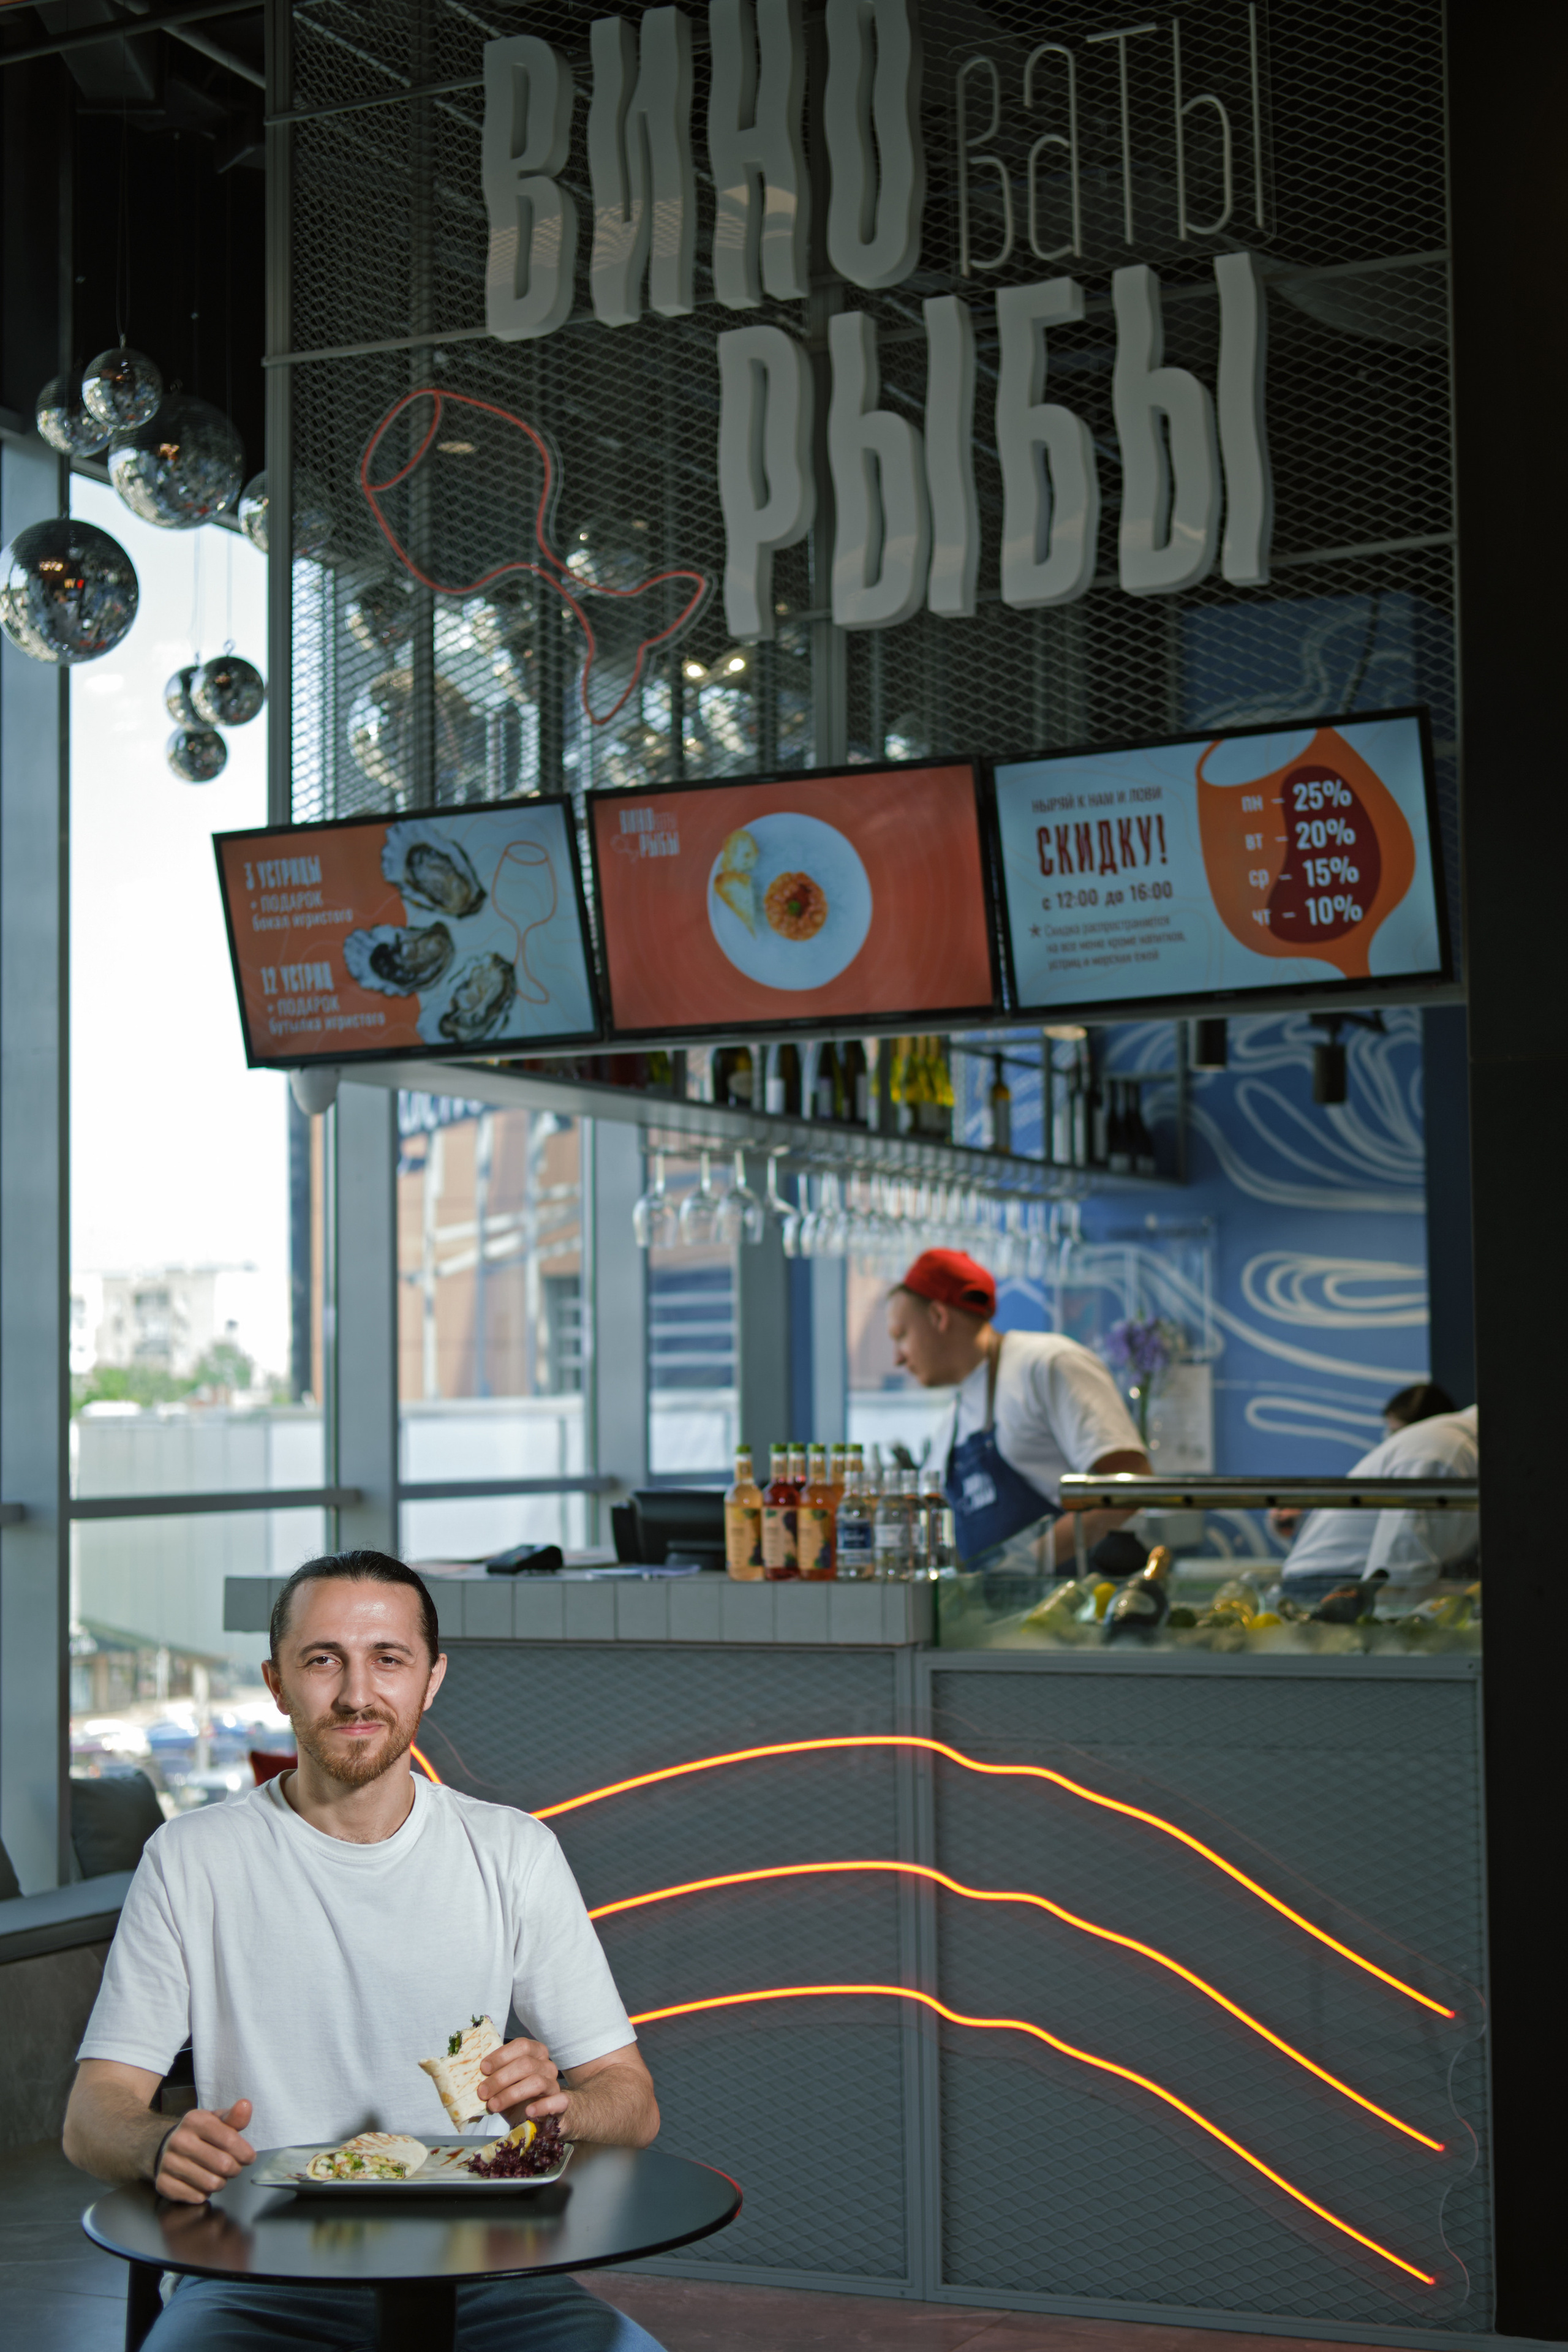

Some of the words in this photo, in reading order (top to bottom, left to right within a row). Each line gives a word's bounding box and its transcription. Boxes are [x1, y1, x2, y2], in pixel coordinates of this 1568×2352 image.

[480, 0, 926, 342] ВИНО
[717, 252, 1272, 641] РЫБЫ
[1031, 792, 1074, 813] НЫРЯЙ
[1088, 791, 1115, 807] НАМ
[1129, 786, 1162, 804] ЛОВИ
[1292, 778, 1352, 812] 25%
[1037, 813, 1167, 877] СКИДКУ!
[1295, 817, 1356, 850] 20%
[257, 855, 322, 889] УСТРИЦЫ
[1302, 856, 1359, 888] 15%
[261, 890, 323, 913] ПОДАРОК
[1057, 888, 1098, 909] 12:00
[1105, 891, 1124, 907] до
[1130, 880, 1173, 902] 16:00
[1305, 894, 1363, 926] 10%
[252, 913, 290, 932] бокал
[292, 908, 353, 930] игристого
[261, 966, 277, 995] 12
[280, 961, 334, 993] УСТРИЦ
[277, 994, 340, 1017] ПОДАРОК
[269, 1017, 322, 1036] бутылка
[325, 1011, 385, 1032] игристого
